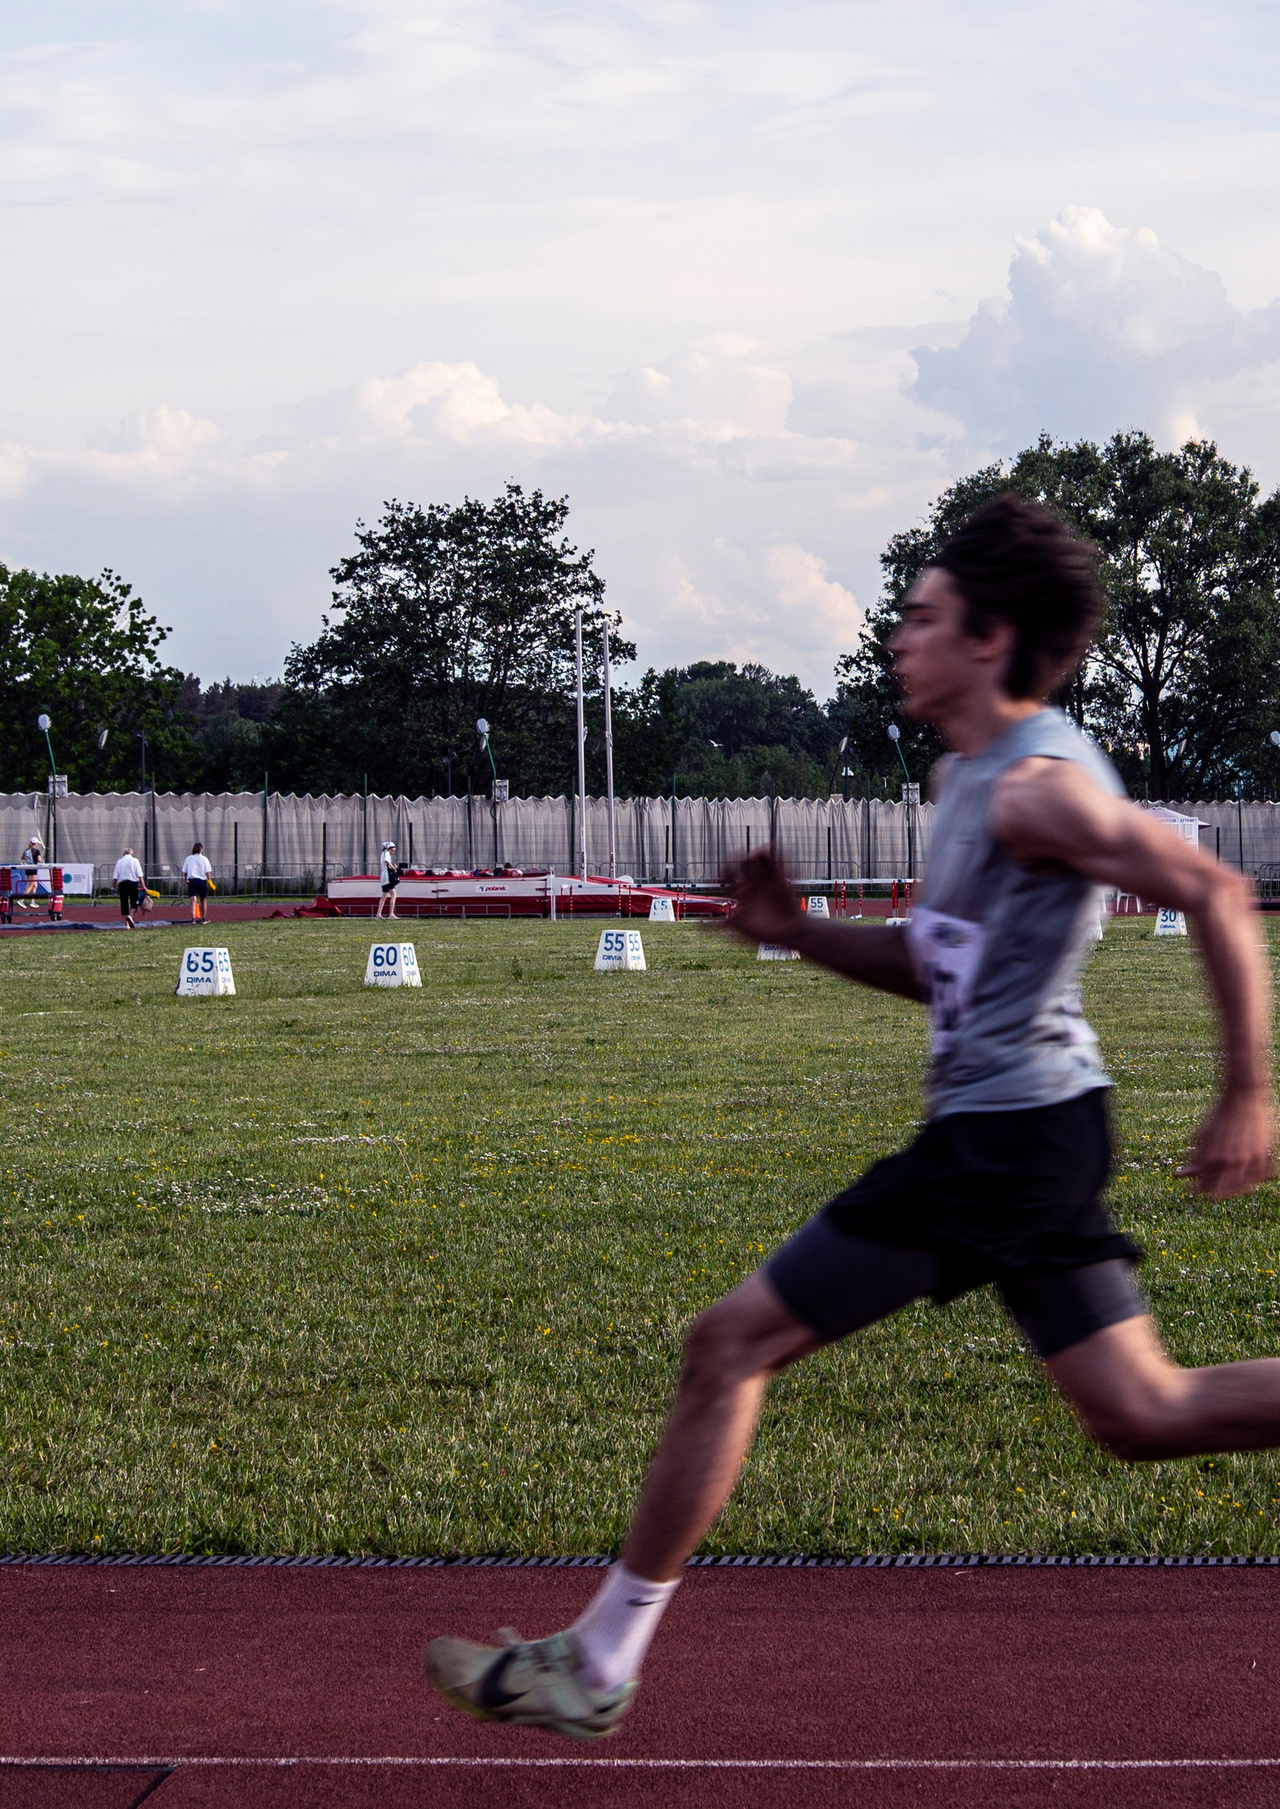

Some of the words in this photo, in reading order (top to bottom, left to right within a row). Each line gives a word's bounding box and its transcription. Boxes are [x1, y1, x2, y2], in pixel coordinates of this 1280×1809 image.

[810, 897, 823, 908] 55
[1160, 909, 1177, 922] 30
[603, 932, 625, 952] 55
[628, 933, 640, 952] 55
[186, 951, 214, 973] 65
[218, 951, 230, 972] 65
[373, 946, 398, 967] 60
[402, 946, 415, 967] 60
